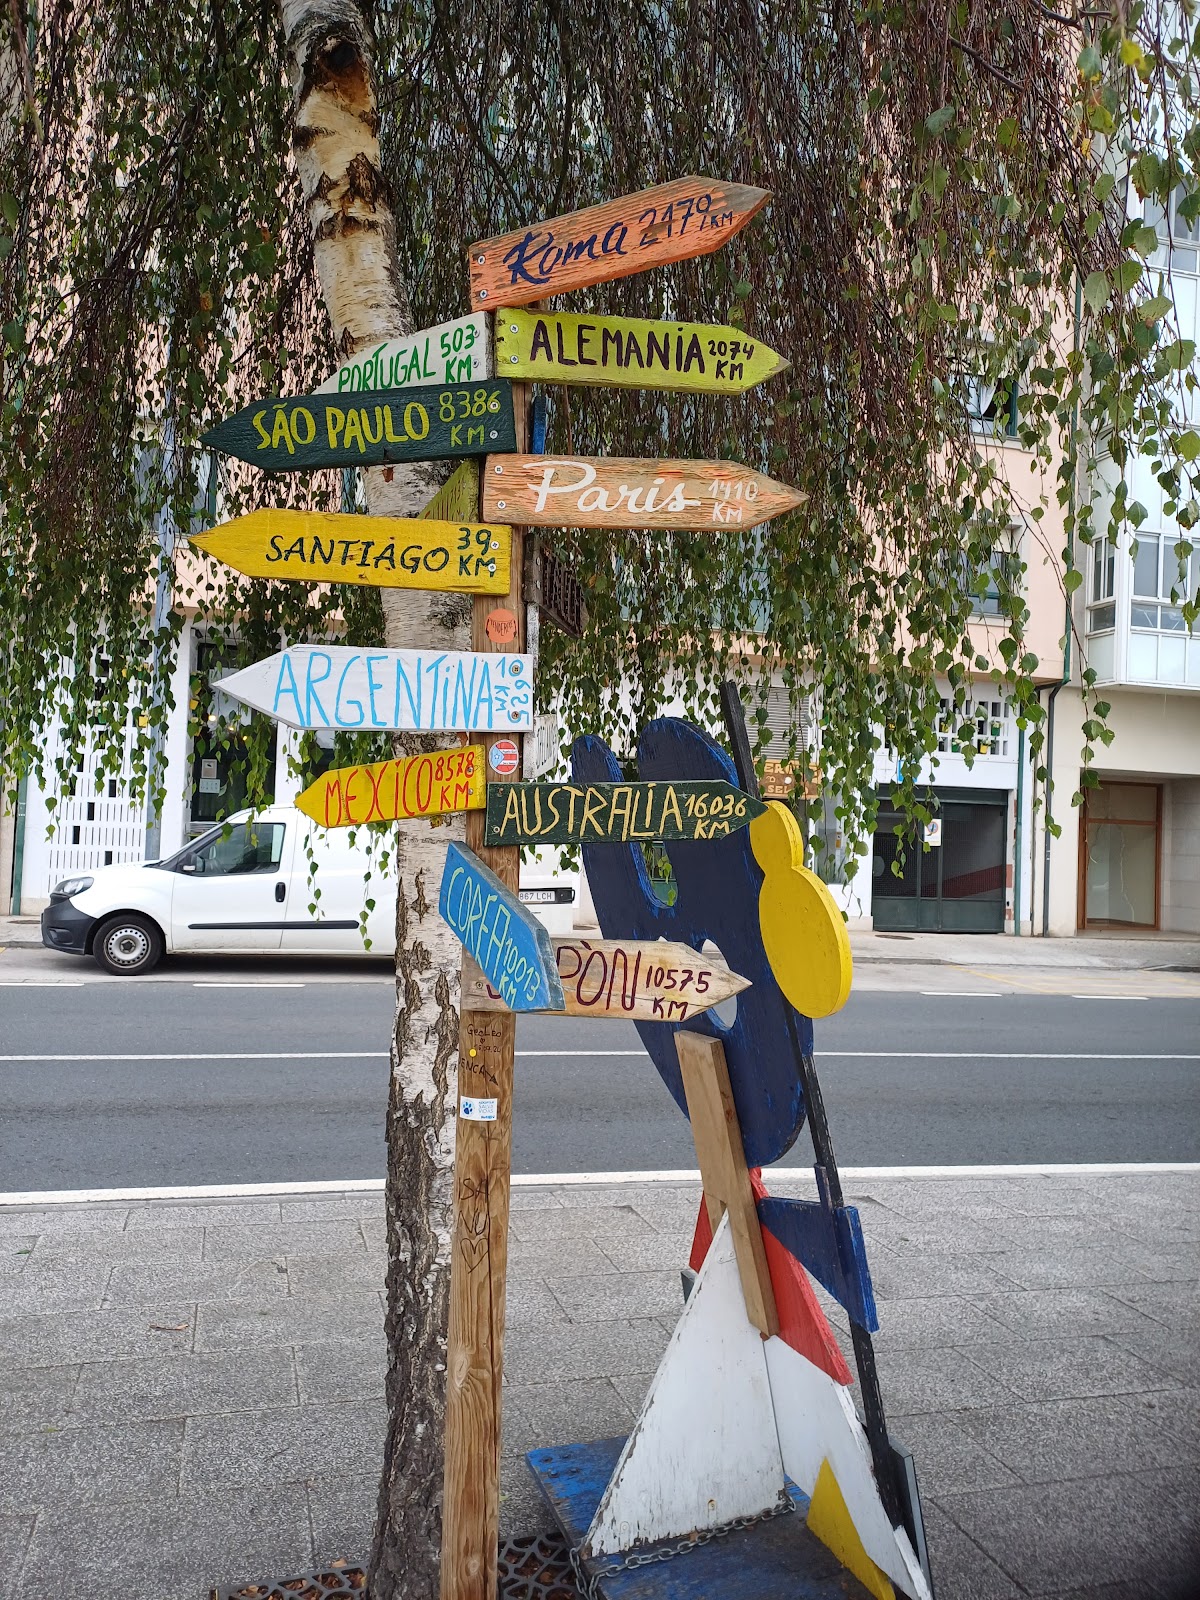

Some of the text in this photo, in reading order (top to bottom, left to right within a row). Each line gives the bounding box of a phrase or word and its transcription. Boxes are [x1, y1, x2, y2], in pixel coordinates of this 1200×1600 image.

[338, 324, 476, 393] PORTUGAL 503
[708, 339, 755, 361] 2074
[445, 354, 472, 384] KM
[715, 360, 744, 381] KM
[252, 389, 502, 455] SÃO PAULO 8386
[450, 424, 485, 448] KM
[522, 460, 701, 513] Paris
[712, 501, 742, 523] KM
[266, 527, 492, 573] SANTIAGO 39
[458, 554, 497, 578] KM
[435, 752, 474, 781] 8578
[440, 781, 469, 810] KM
[685, 793, 747, 817] 16036
[694, 819, 730, 840] KM
[447, 867, 541, 1002] COREA 10013
[499, 971, 518, 1008] KM
[646, 965, 712, 993] 10575
[653, 997, 689, 1021] KM
